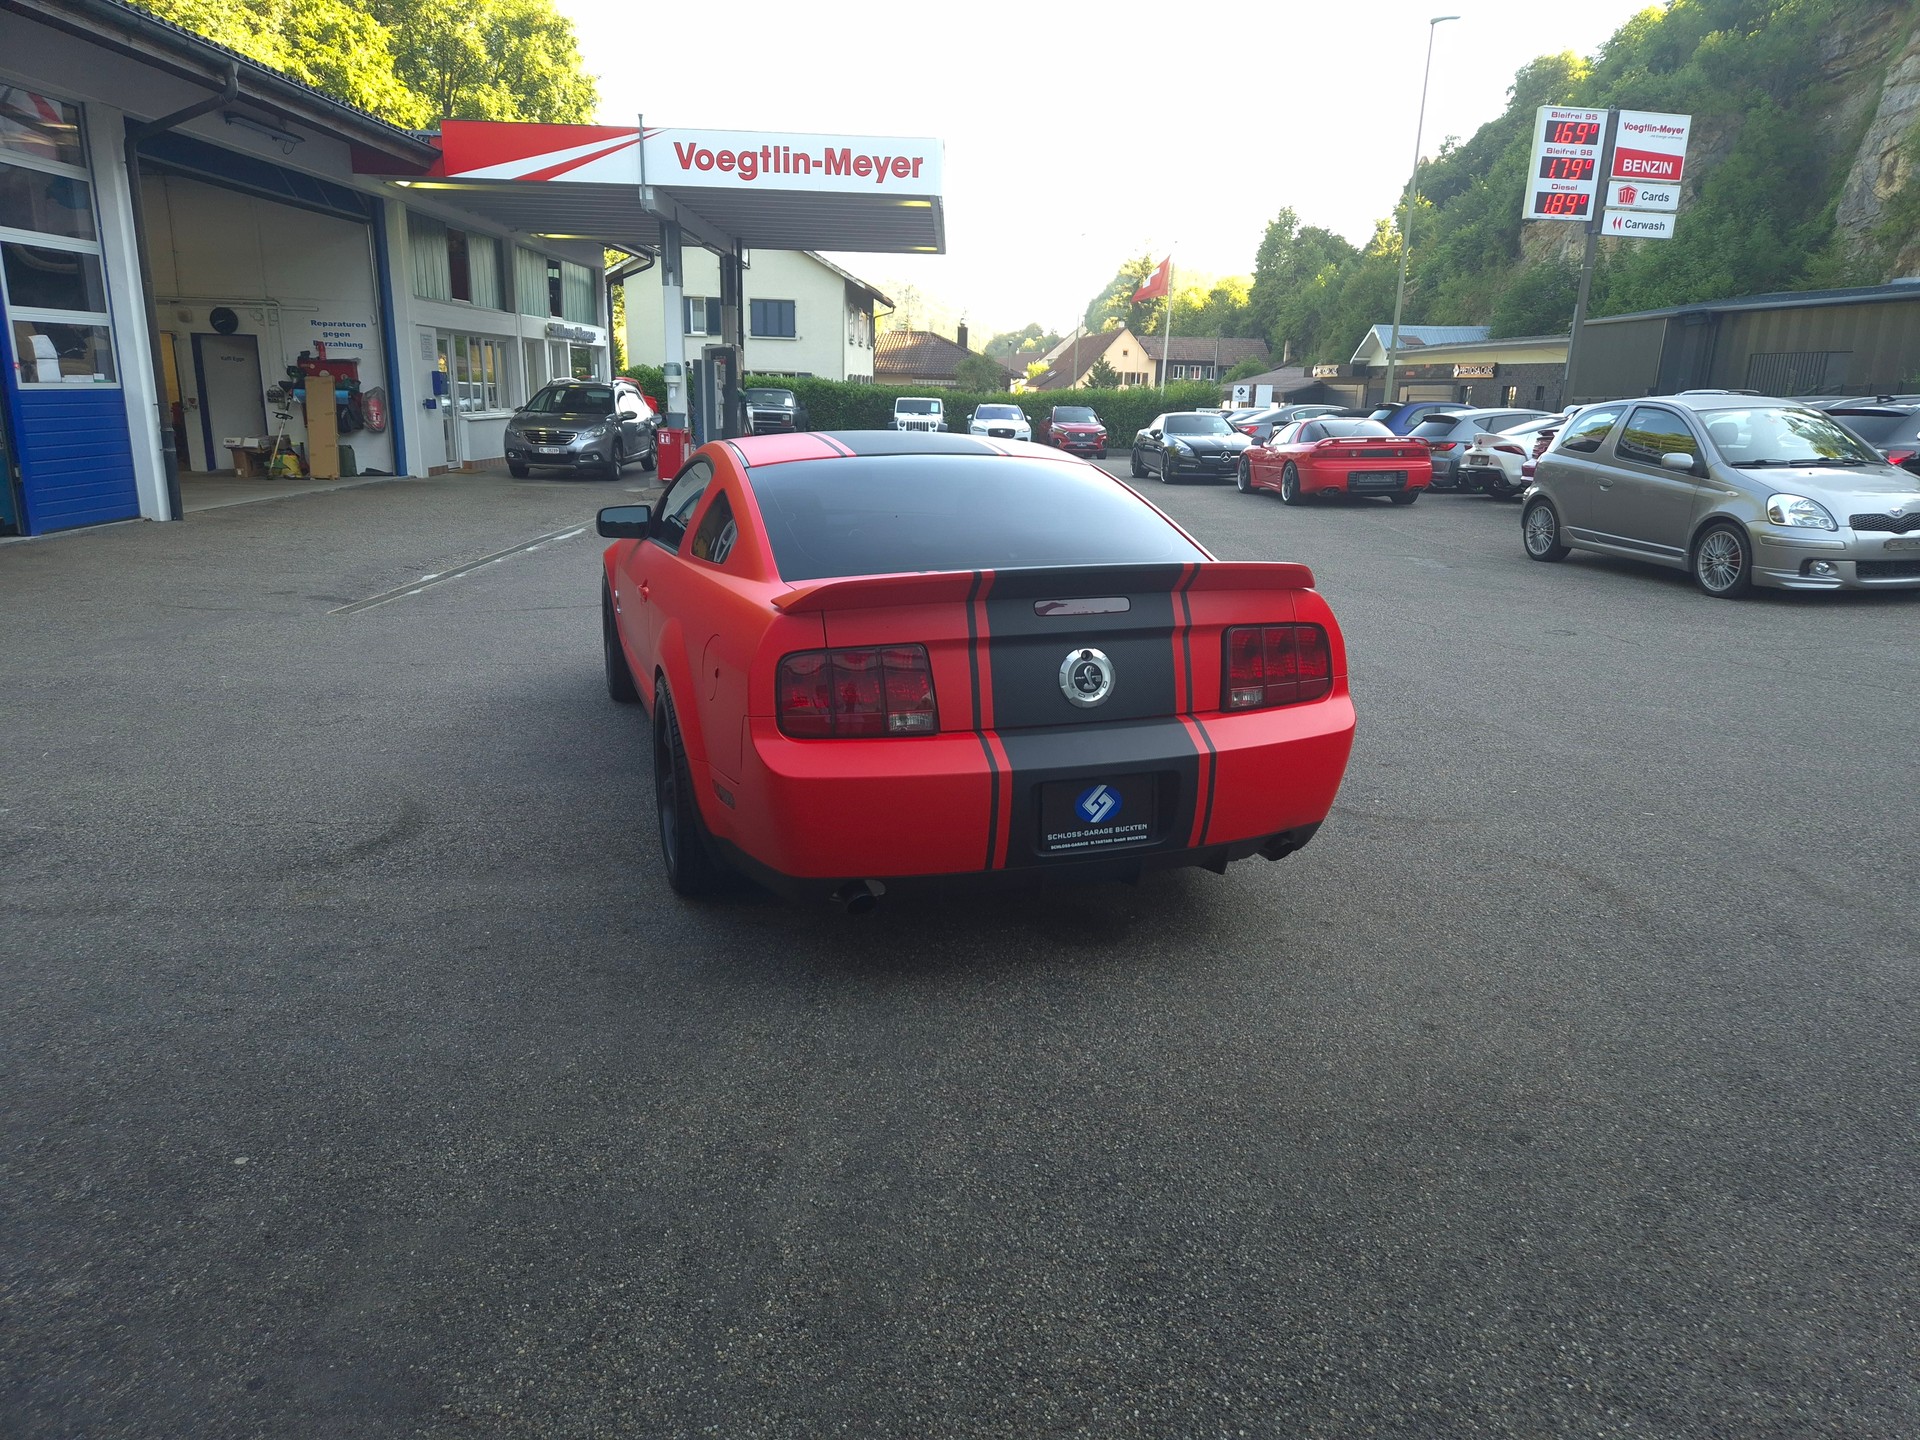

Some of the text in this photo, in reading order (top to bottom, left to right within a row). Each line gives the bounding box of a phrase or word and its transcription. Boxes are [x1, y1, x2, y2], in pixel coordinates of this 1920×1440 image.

[1551, 111, 1598, 121] Bleifrei 95
[1623, 122, 1685, 135] Voegtlin-Meyer
[1546, 147, 1578, 156] Bleifrei
[673, 142, 924, 184] Voegtlin-Meyer
[1622, 159, 1673, 175] BENZIN
[1551, 183, 1578, 191] Diesel
[1641, 191, 1670, 202] Cards
[1625, 219, 1666, 231] Carwash
[310, 320, 367, 328] Reparaturen
[313, 340, 364, 349] Brzahlung
[1047, 823, 1148, 841] SCHLOSS-GARAGE BUCKTEN
[1050, 841, 1089, 850] SCHLOSS-GARAGE
